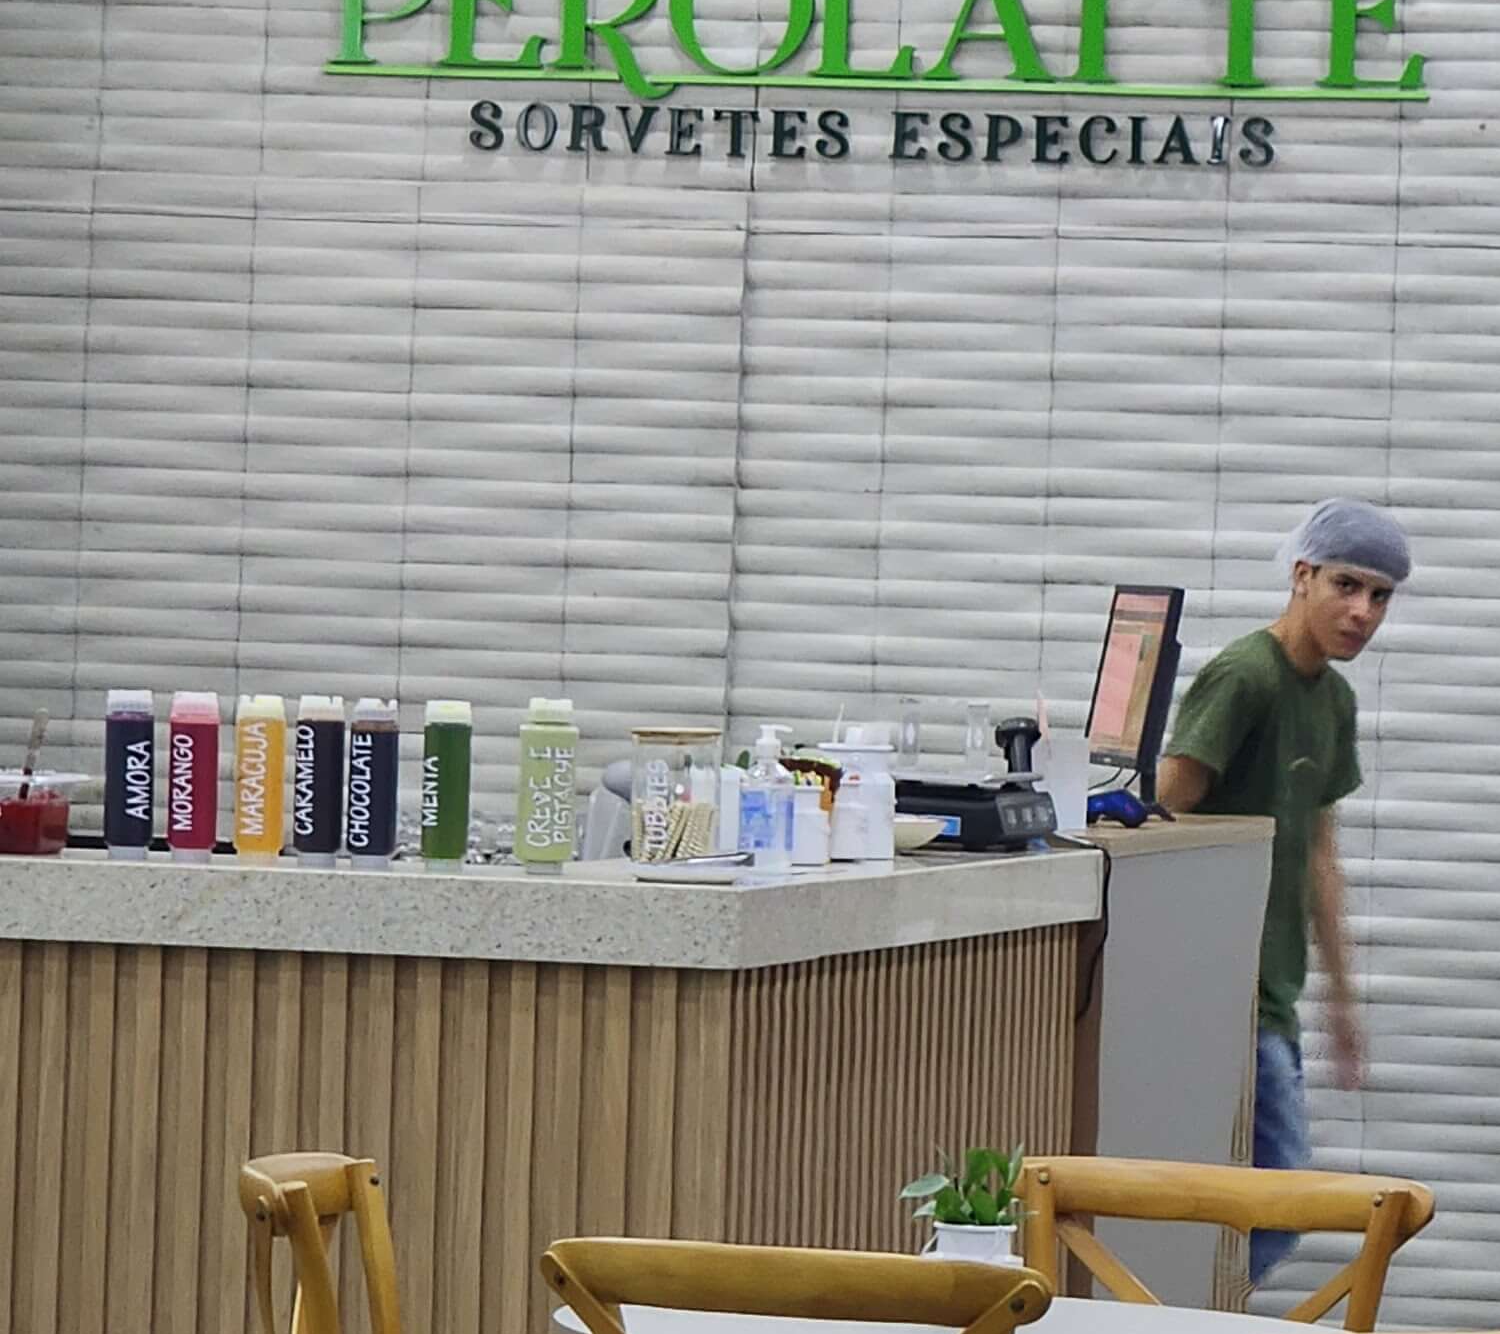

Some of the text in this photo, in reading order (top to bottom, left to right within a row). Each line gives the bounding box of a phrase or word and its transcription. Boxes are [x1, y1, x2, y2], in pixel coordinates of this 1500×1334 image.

[469, 100, 1276, 166] SORVETES ESPECIAIS
[125, 740, 151, 820] AMORA
[172, 734, 194, 831] MORANGO
[294, 725, 315, 835] CARAMELO
[348, 733, 373, 847] CHOCOLATE
